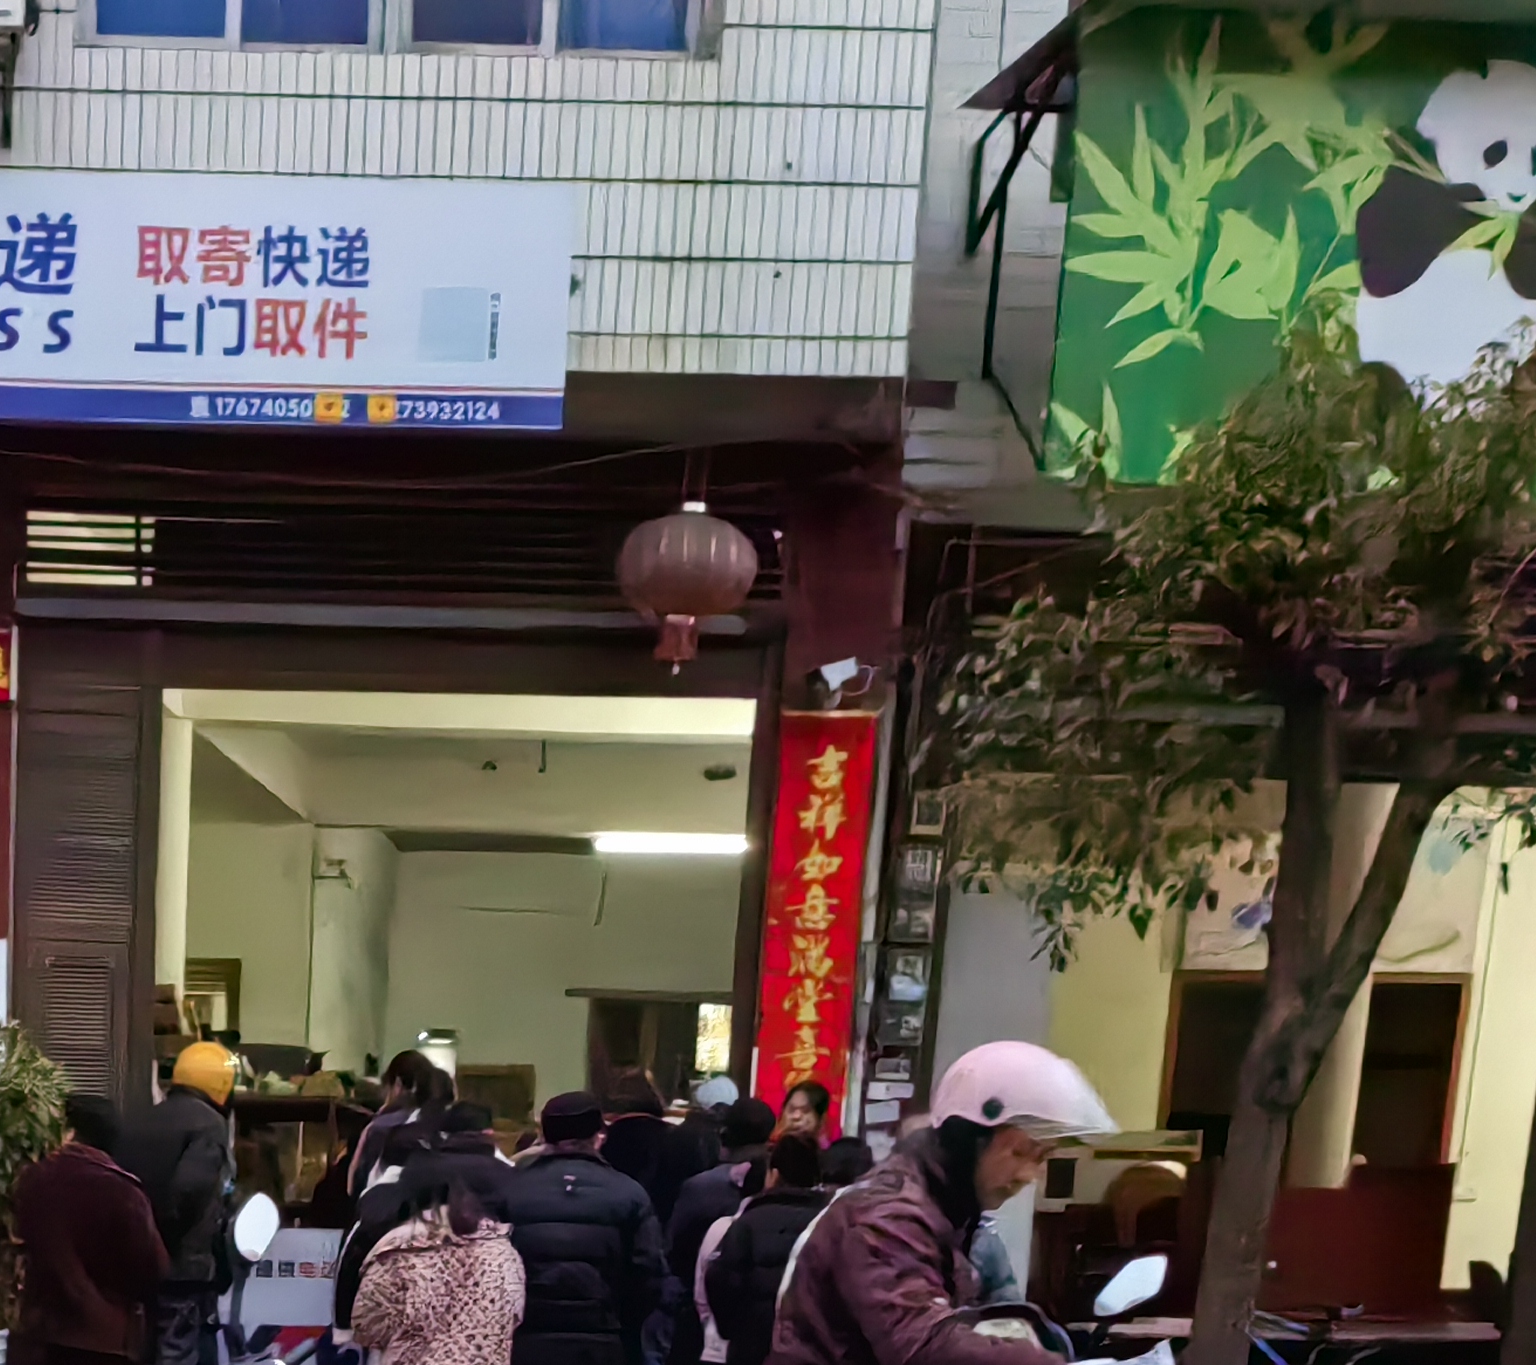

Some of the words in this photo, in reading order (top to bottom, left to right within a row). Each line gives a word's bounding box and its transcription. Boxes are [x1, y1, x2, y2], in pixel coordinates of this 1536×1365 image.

[137, 223, 370, 289] 取寄快递
[134, 294, 368, 358] 上门取件
